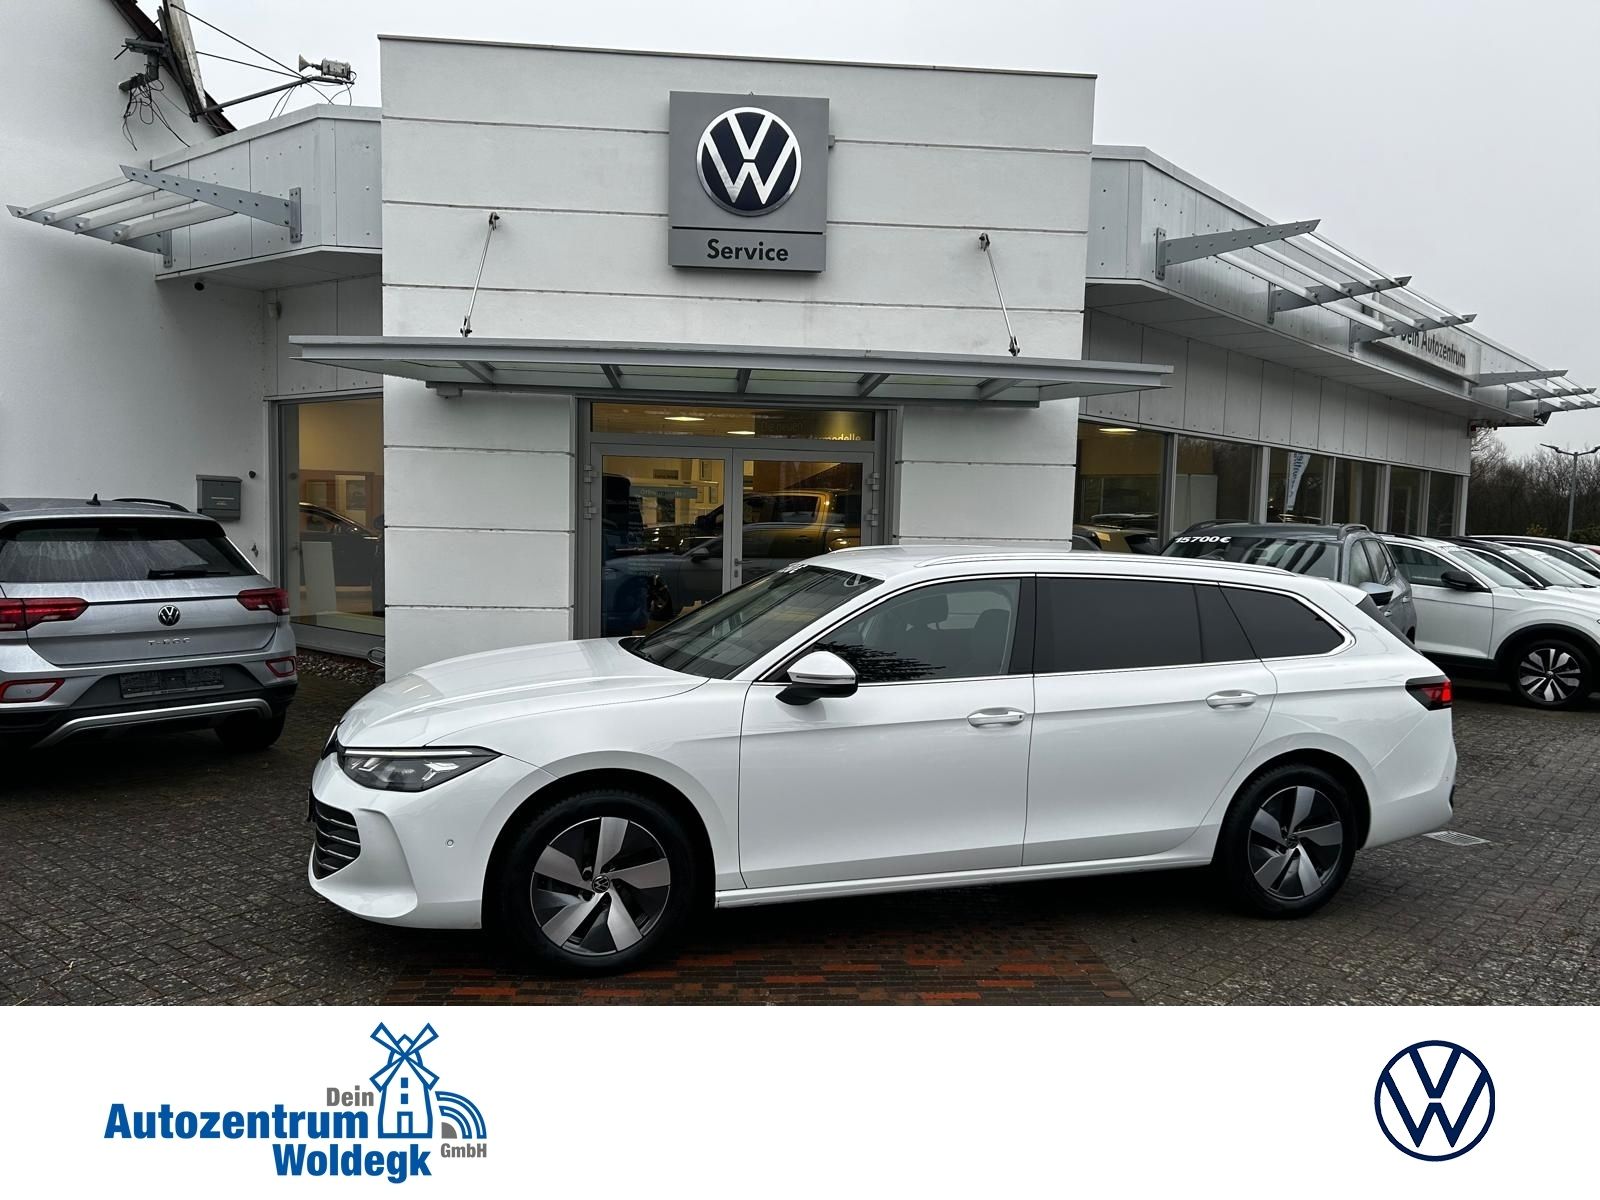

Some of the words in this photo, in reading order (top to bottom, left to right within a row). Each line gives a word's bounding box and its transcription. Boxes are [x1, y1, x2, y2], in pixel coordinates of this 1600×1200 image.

[698, 108, 800, 212] VW
[706, 238, 789, 262] Service
[1420, 331, 1466, 369] Autozentrum
